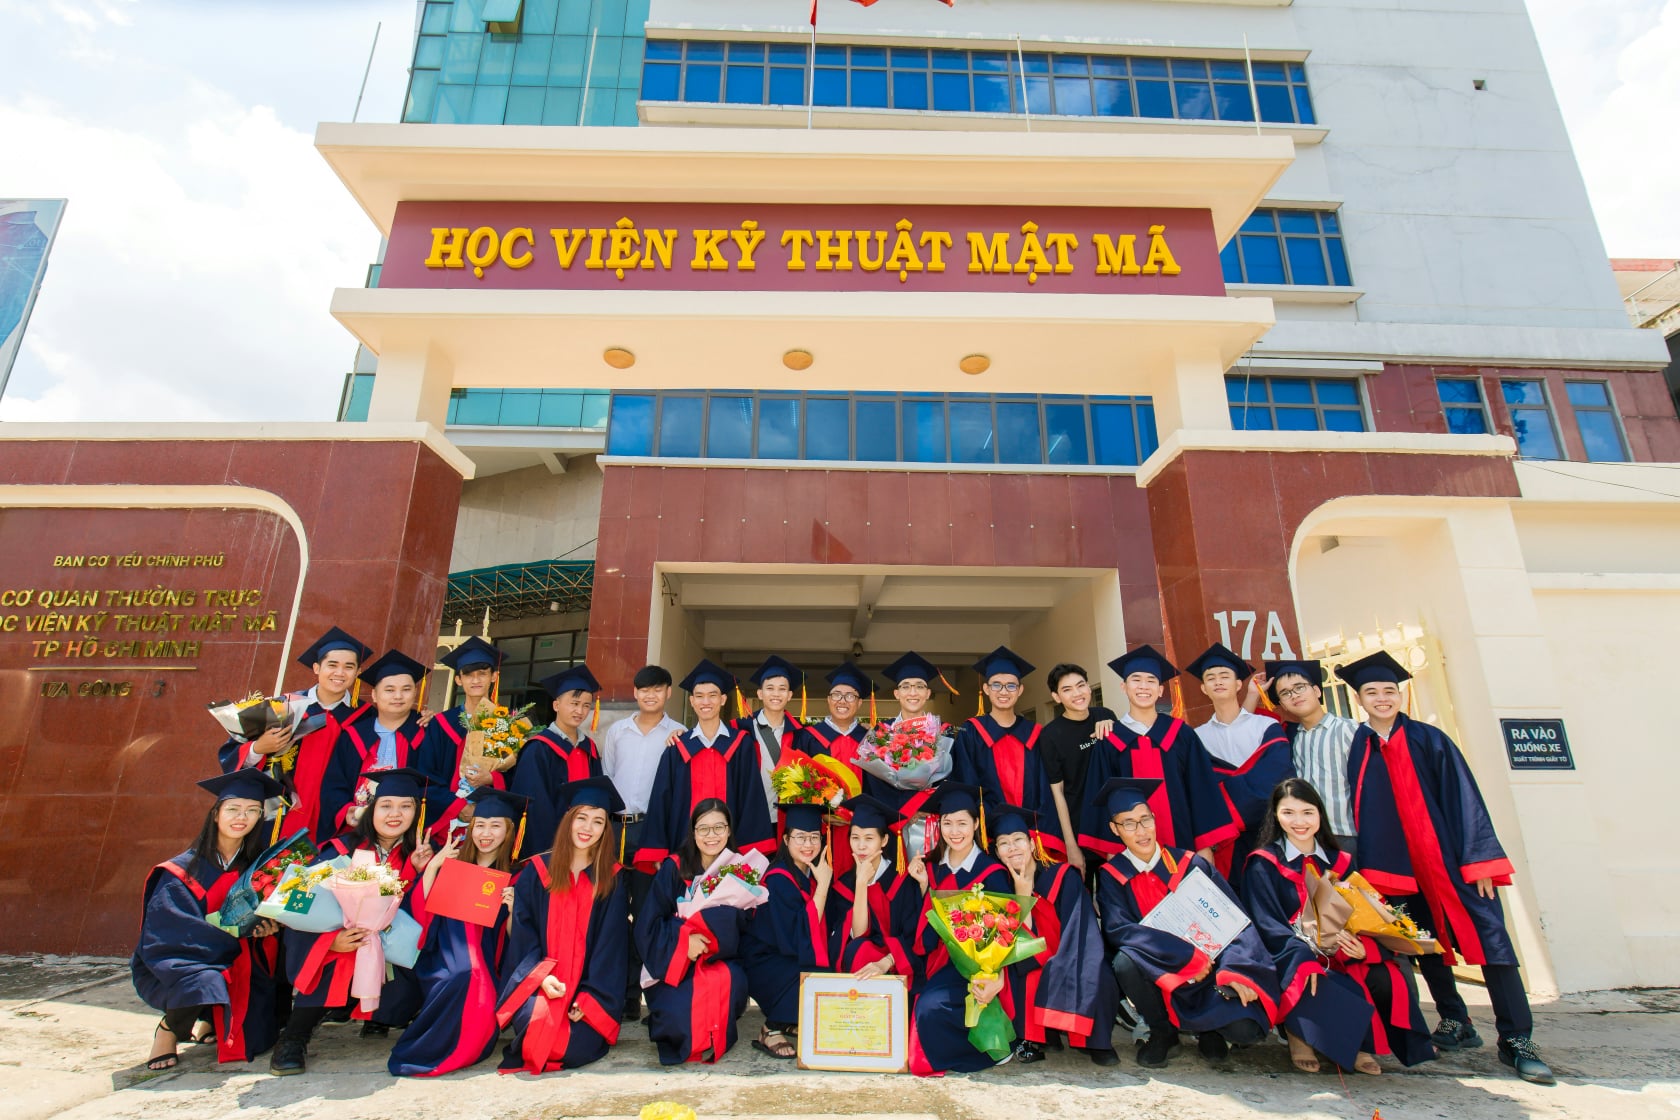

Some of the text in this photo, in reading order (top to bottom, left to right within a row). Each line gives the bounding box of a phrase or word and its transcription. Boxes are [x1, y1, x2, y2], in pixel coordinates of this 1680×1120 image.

[425, 217, 1182, 284] HỌC VIỆN KỸ THUẬT MẬT MÃ
[53, 555, 85, 567] BAN
[87, 555, 110, 567] CƠ
[115, 550, 142, 567] YẾU
[1, 584, 262, 611] CƠ QUAN THƯỜNG TRỰC
[25, 611, 73, 636] VIỆN
[75, 610, 109, 632] KỸ
[114, 610, 185, 636] THUẬT
[189, 610, 238, 637] MẬT
[242, 610, 279, 632] MÃ
[1213, 610, 1296, 661] 17A
[32, 640, 60, 658] TP
[65, 634, 100, 658] HỒ
[143, 640, 202, 658] MINH
[1511, 726, 1556, 739] RA VÀO
[1513, 741, 1562, 752] XUỐNG XE
